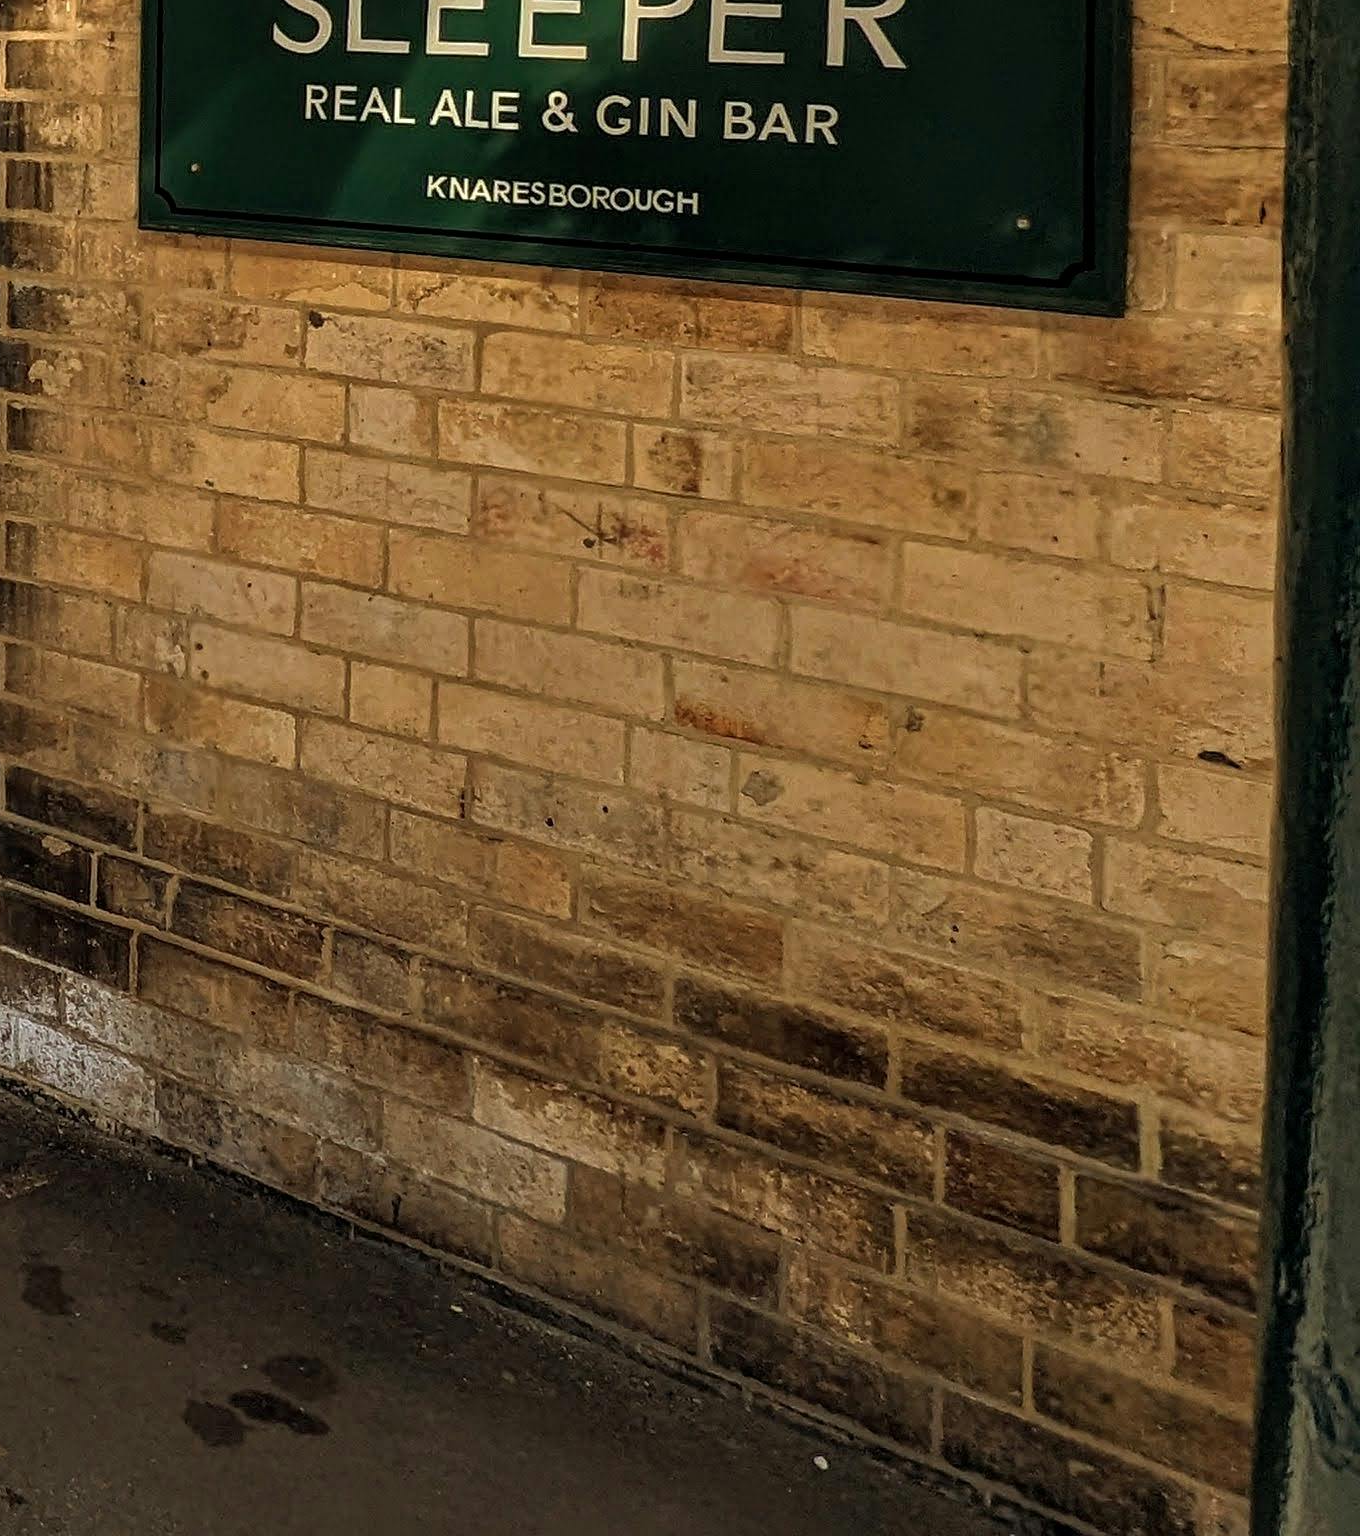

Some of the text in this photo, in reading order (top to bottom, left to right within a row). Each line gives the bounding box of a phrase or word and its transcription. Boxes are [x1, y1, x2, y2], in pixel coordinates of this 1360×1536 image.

[304, 83, 840, 146] REAL ALE & GIN BAR
[425, 174, 700, 216] KNARESBOROUGH
